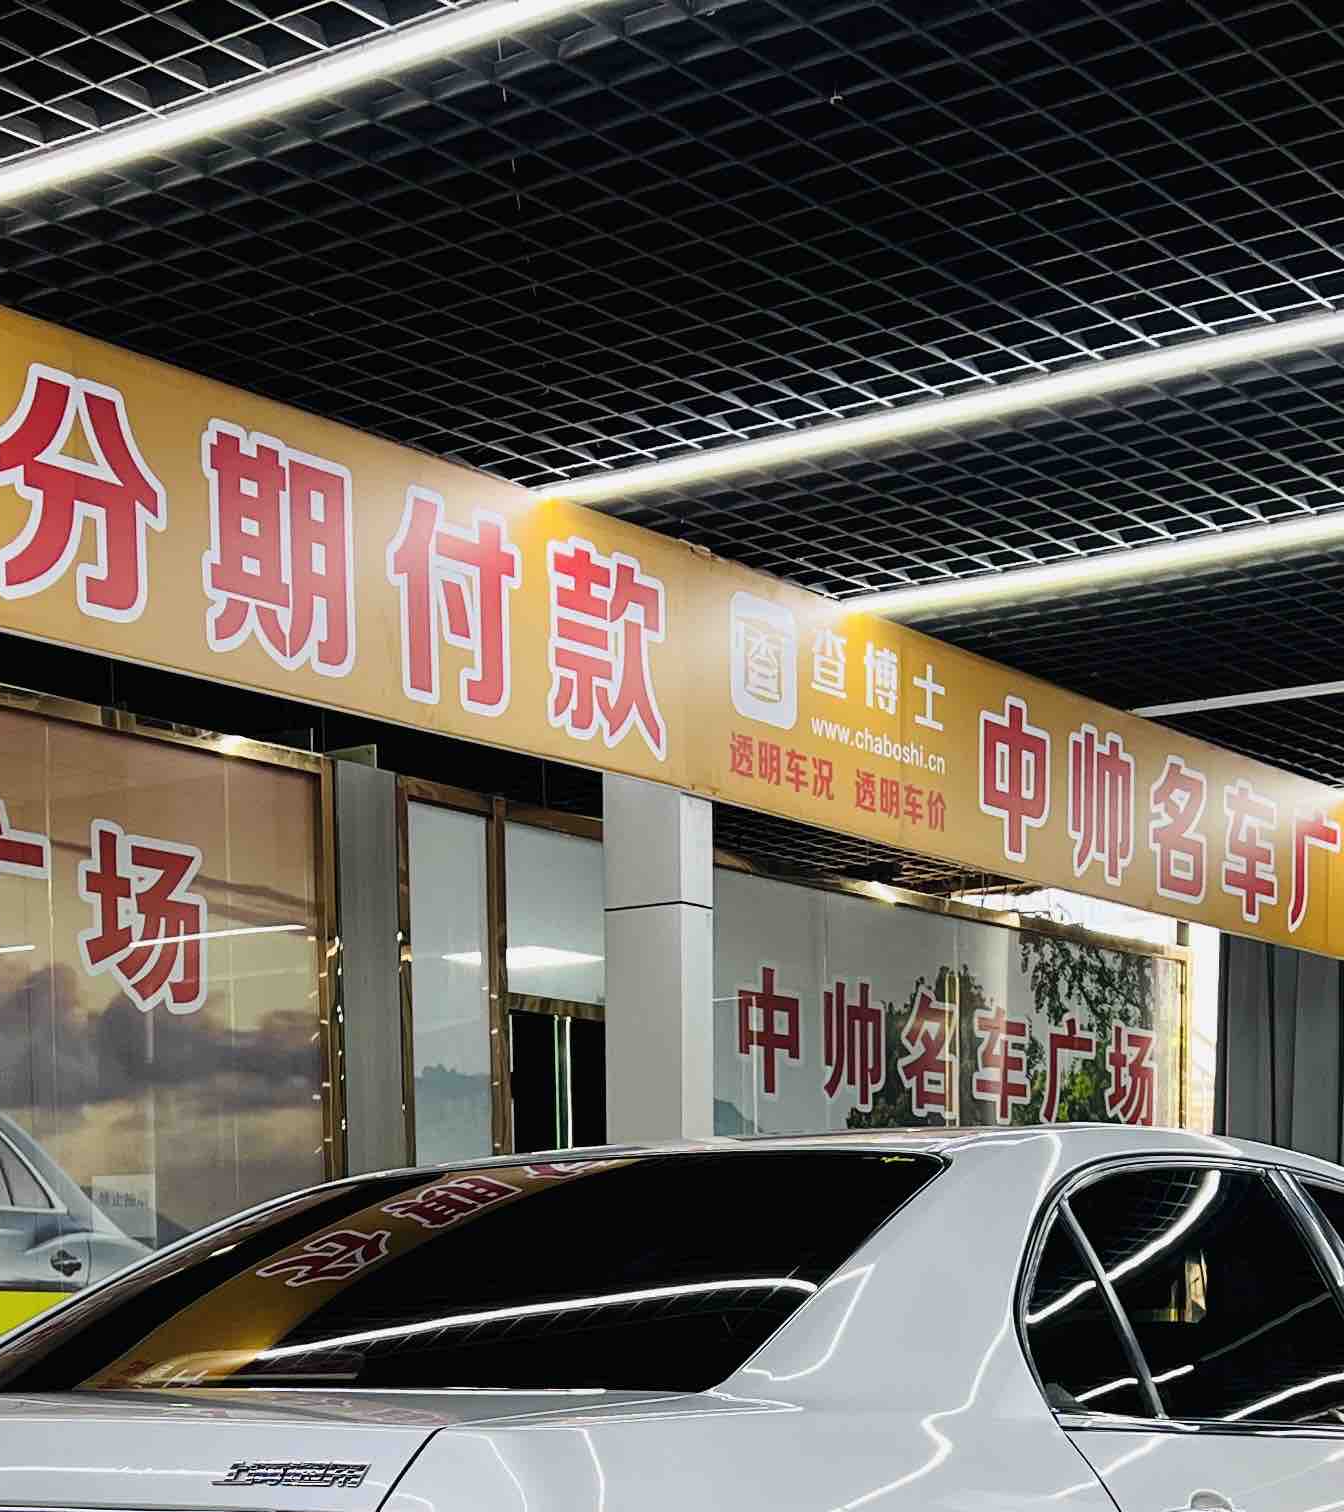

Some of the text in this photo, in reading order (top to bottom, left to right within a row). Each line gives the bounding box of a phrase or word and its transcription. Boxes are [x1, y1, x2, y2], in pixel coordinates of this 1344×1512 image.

[810, 628, 946, 732] 查博士
[729, 732, 946, 832] 透明车况 透明车价
[810, 716, 946, 776] www.chaboshi.cn
[736, 966, 1159, 1127] 中帅名车广场
